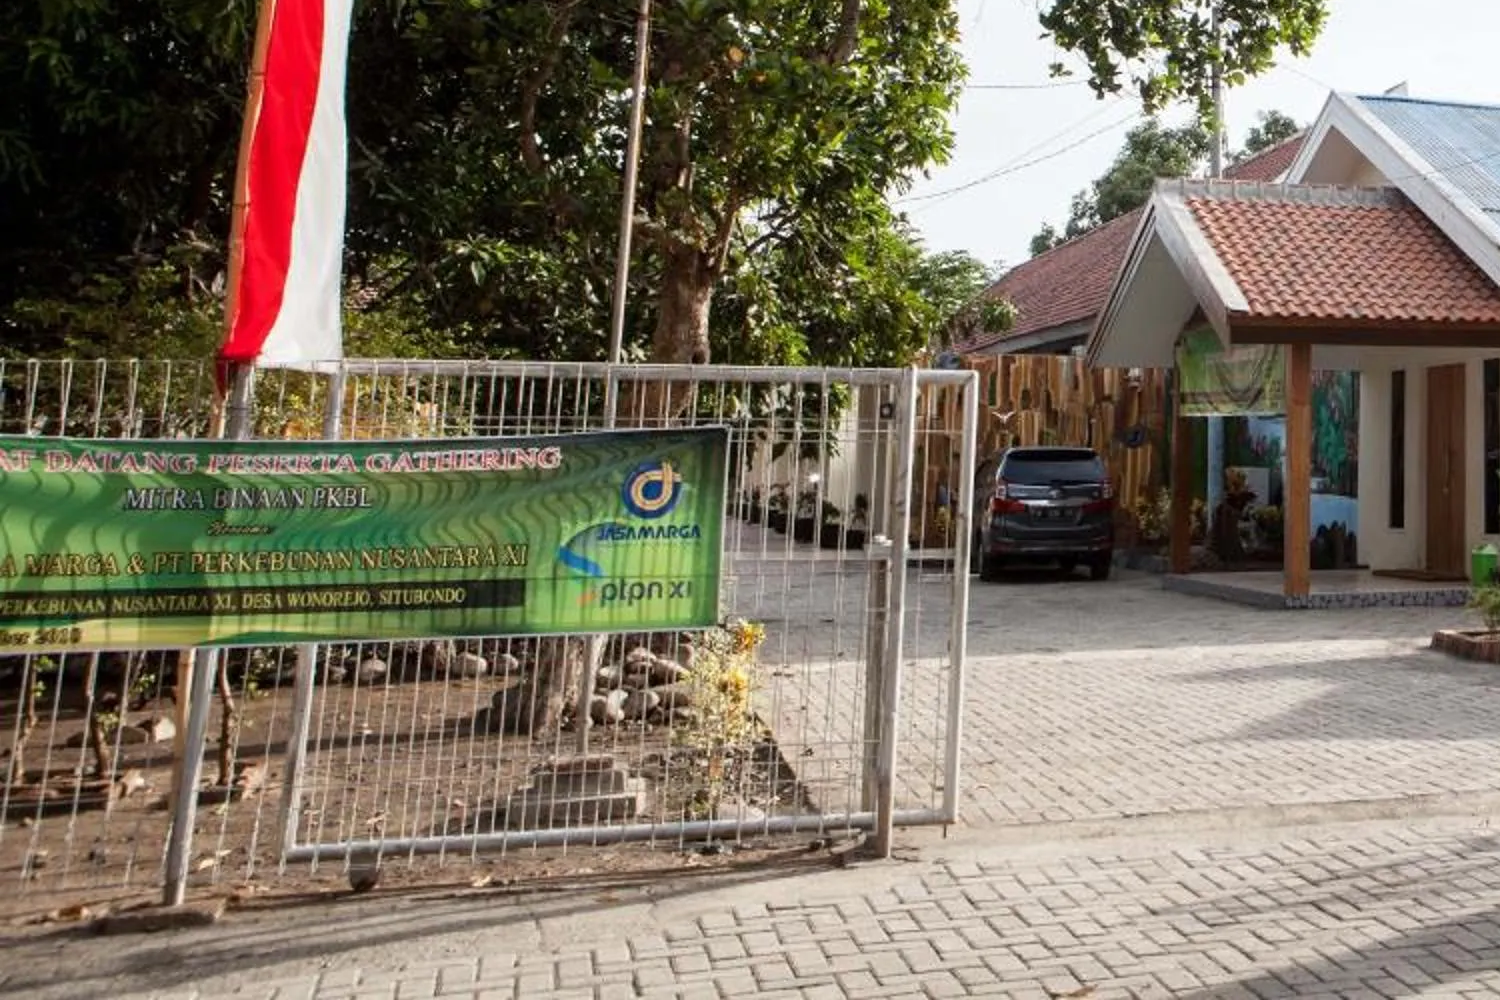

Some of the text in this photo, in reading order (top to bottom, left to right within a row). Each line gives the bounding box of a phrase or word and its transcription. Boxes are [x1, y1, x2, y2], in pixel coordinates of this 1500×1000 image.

[44, 450, 198, 475] DATANG
[206, 453, 358, 475] PESERTA
[365, 446, 563, 473] GATHERING
[125, 486, 373, 510] MITRA BINAAN PKBL
[597, 523, 701, 540] JASAMARGA
[25, 552, 120, 576] MARGA
[127, 551, 145, 575] &
[153, 550, 185, 574] PT
[191, 549, 354, 573] PERKEBUNAN
[361, 544, 498, 571] NUSANTARA
[505, 543, 529, 567] XI
[112, 594, 210, 614] NUSANTARA
[242, 591, 284, 610] DESA
[379, 586, 467, 606] SITUBONDO
[601, 578, 663, 608] ptpn
